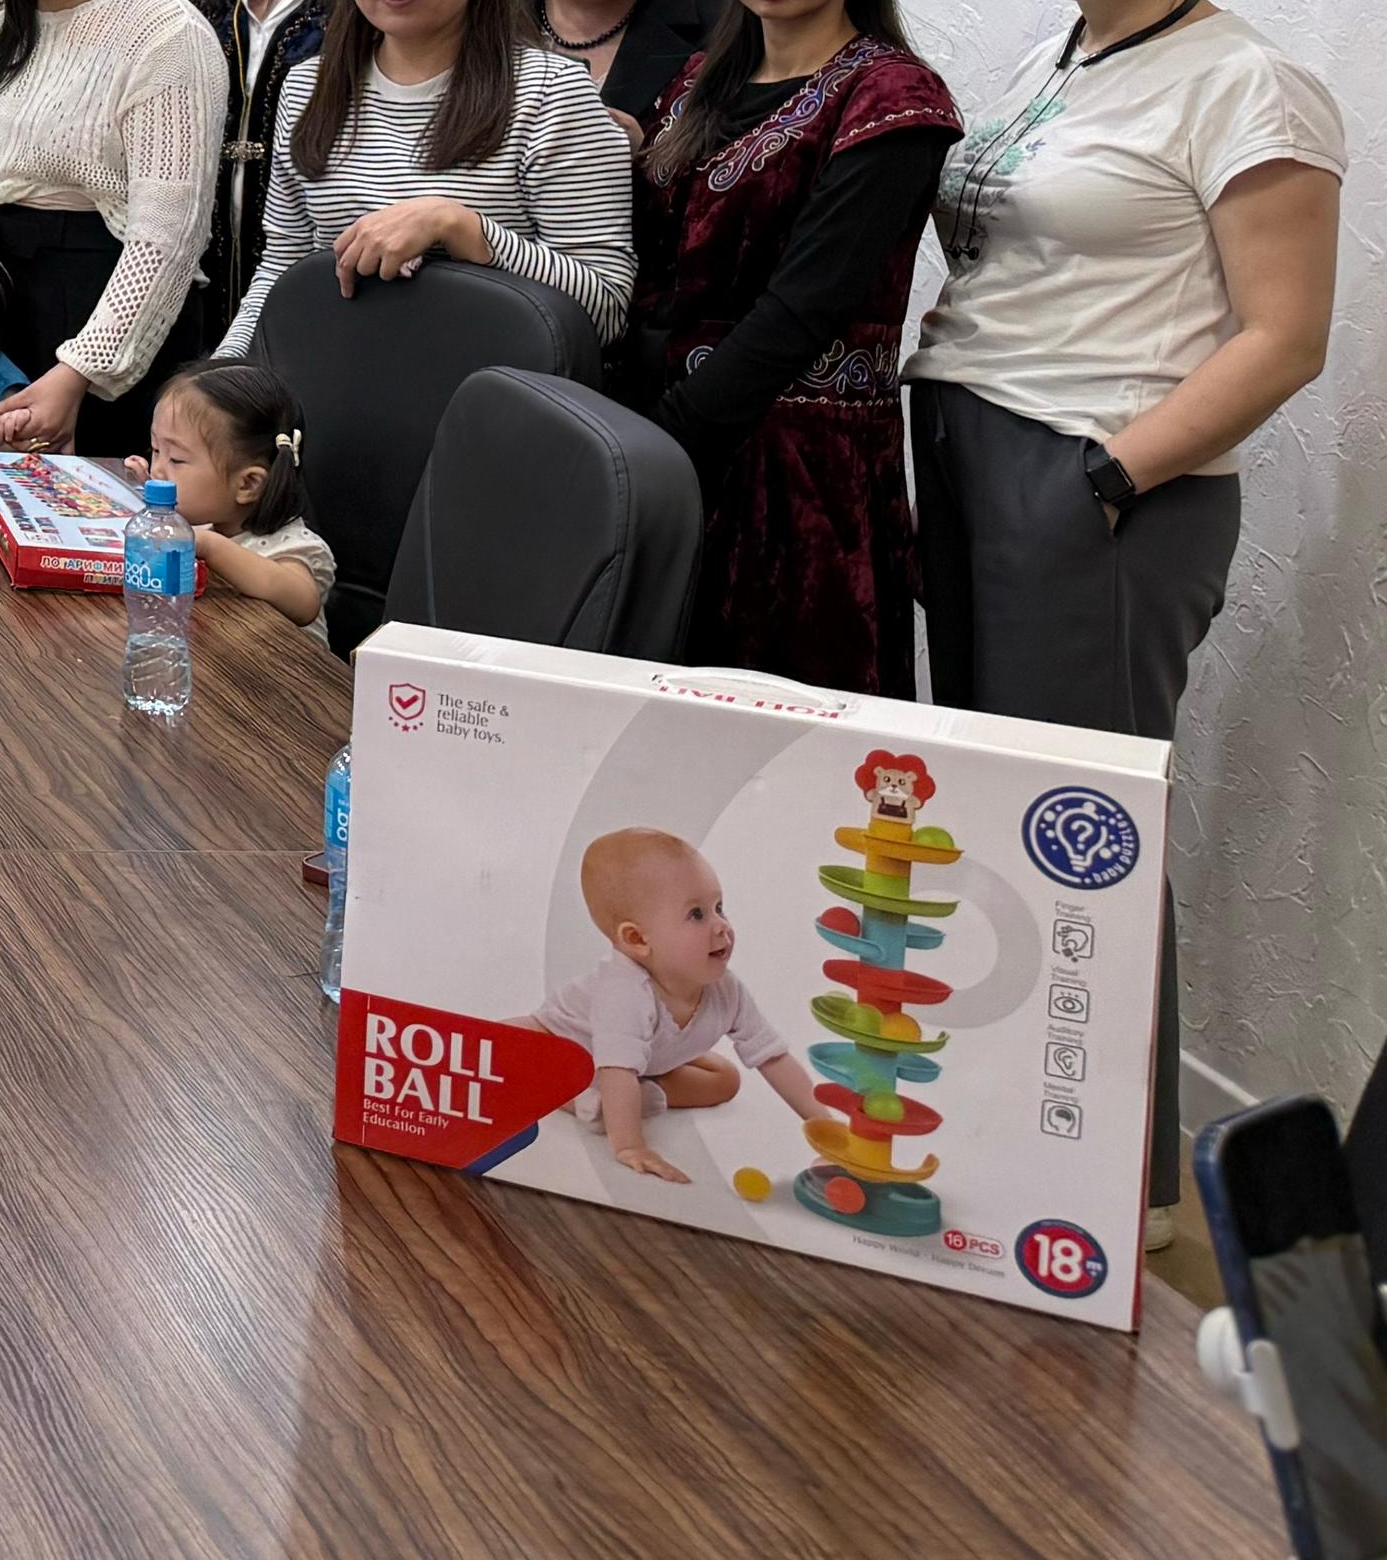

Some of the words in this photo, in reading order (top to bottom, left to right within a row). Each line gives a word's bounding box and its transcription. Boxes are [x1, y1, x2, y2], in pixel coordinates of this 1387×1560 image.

[40, 555, 124, 574] ЛОГАРИФМИ
[437, 693, 463, 709] The
[466, 698, 497, 715] safe
[499, 704, 510, 718] &
[437, 708, 490, 728] reliable
[436, 719, 471, 741] baby
[473, 728, 506, 745] toys.
[1092, 862, 1126, 884] baby
[1116, 820, 1135, 865] puzzle
[365, 1012, 505, 1084] ROLL
[364, 1056, 493, 1125] BALL
[362, 1111, 426, 1136] Education
[363, 1098, 391, 1115] Best
[394, 1105, 415, 1120] For
[418, 1111, 450, 1130] Early
[946, 1232, 964, 1247] 16
[968, 1238, 1001, 1256] PCS
[1032, 1233, 1085, 1283] 18
